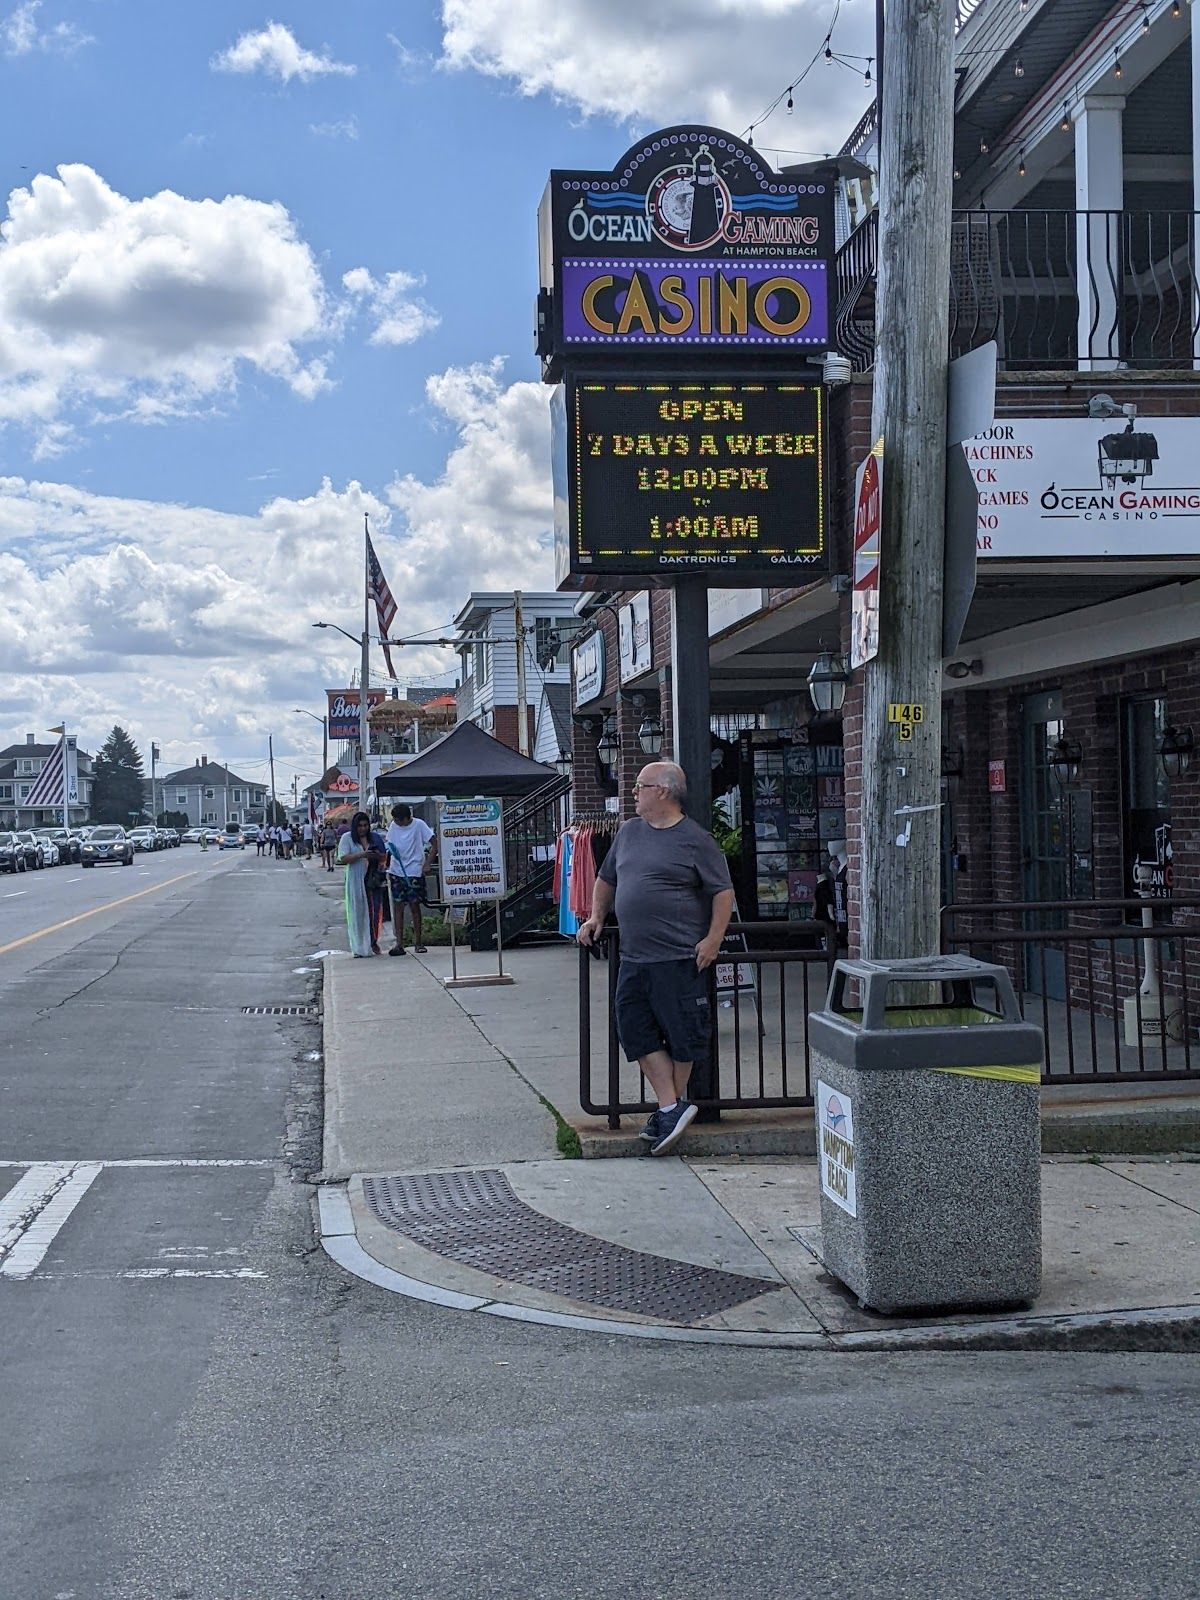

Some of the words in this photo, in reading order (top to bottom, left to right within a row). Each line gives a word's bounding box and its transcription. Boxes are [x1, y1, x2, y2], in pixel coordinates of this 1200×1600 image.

[568, 209, 654, 242] OCEAN
[722, 211, 819, 244] GAMING
[736, 248, 784, 256] HAMPTON
[786, 248, 818, 256] BEACH
[582, 272, 811, 336] CASINO
[658, 400, 743, 421] OPEN
[587, 434, 602, 455] 7
[612, 434, 690, 455] DAYS
[699, 434, 719, 455] A
[726, 434, 816, 456] WEEK
[637, 467, 769, 490] 12:00PM
[971, 469, 998, 482] CK
[978, 491, 1029, 505] GAMES
[1040, 491, 1114, 510] OCEAN
[1119, 491, 1200, 510] GAMING
[858, 502, 866, 536] DO
[868, 486, 878, 527] NOT
[1084, 512, 1158, 521] CASINO
[650, 515, 759, 538] 1:00AM
[659, 555, 737, 563] DAKTRONICS
[770, 555, 819, 563] GALAXY
[892, 705, 922, 721] 146
[901, 723, 911, 739] 5
[756, 797, 781, 806] DOPE
[443, 828, 470, 837] CUSTOM
[452, 849, 476, 857] shorts
[1133, 863, 1165, 886] OAN
[450, 888, 457, 896] of
[727, 964, 744, 973] CL
